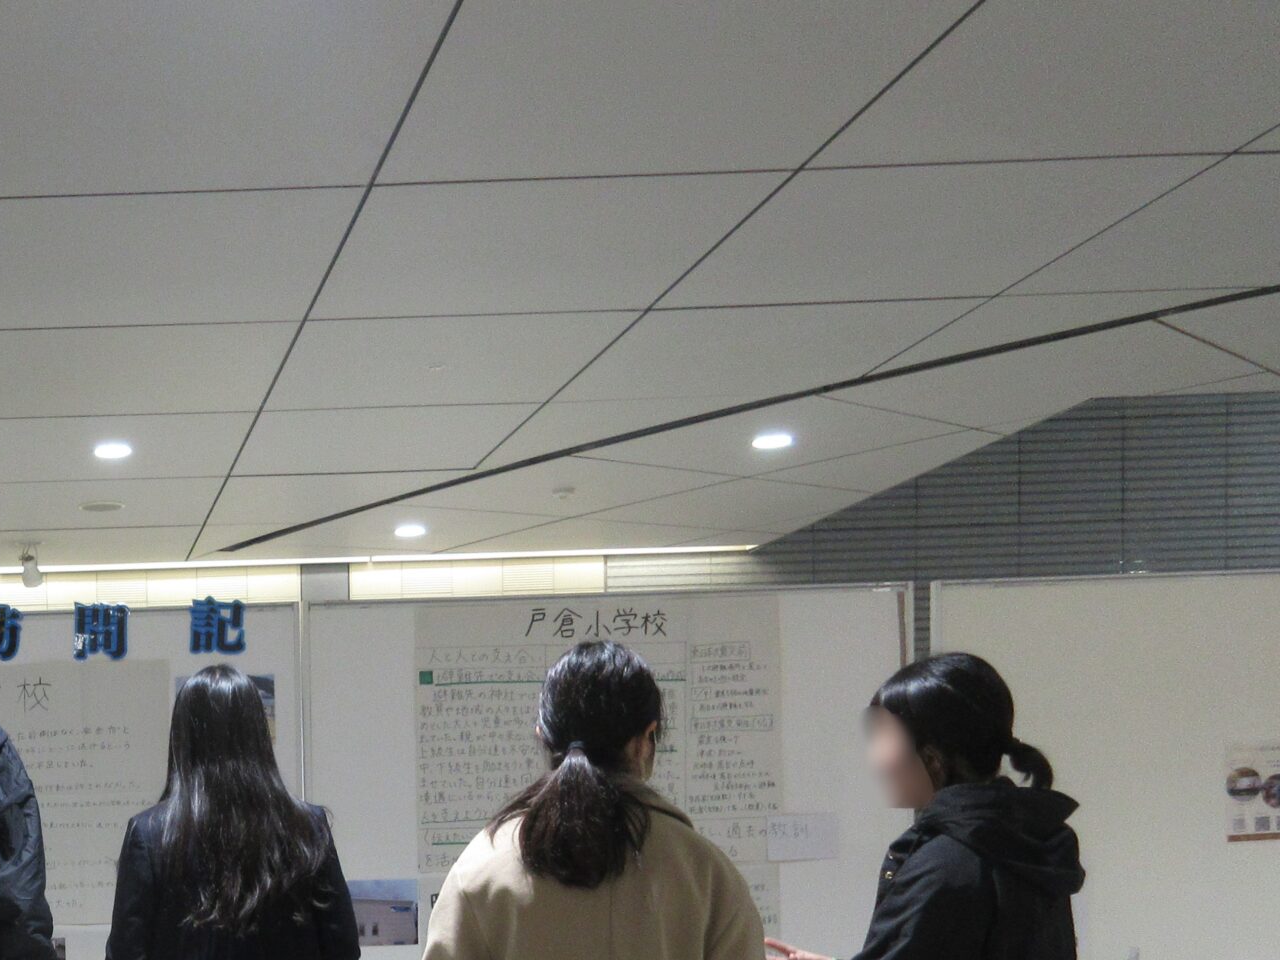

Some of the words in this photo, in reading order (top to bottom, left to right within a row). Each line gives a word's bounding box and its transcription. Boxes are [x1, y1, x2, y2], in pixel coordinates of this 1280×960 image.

[525, 608, 668, 638] 戸倉小学校
